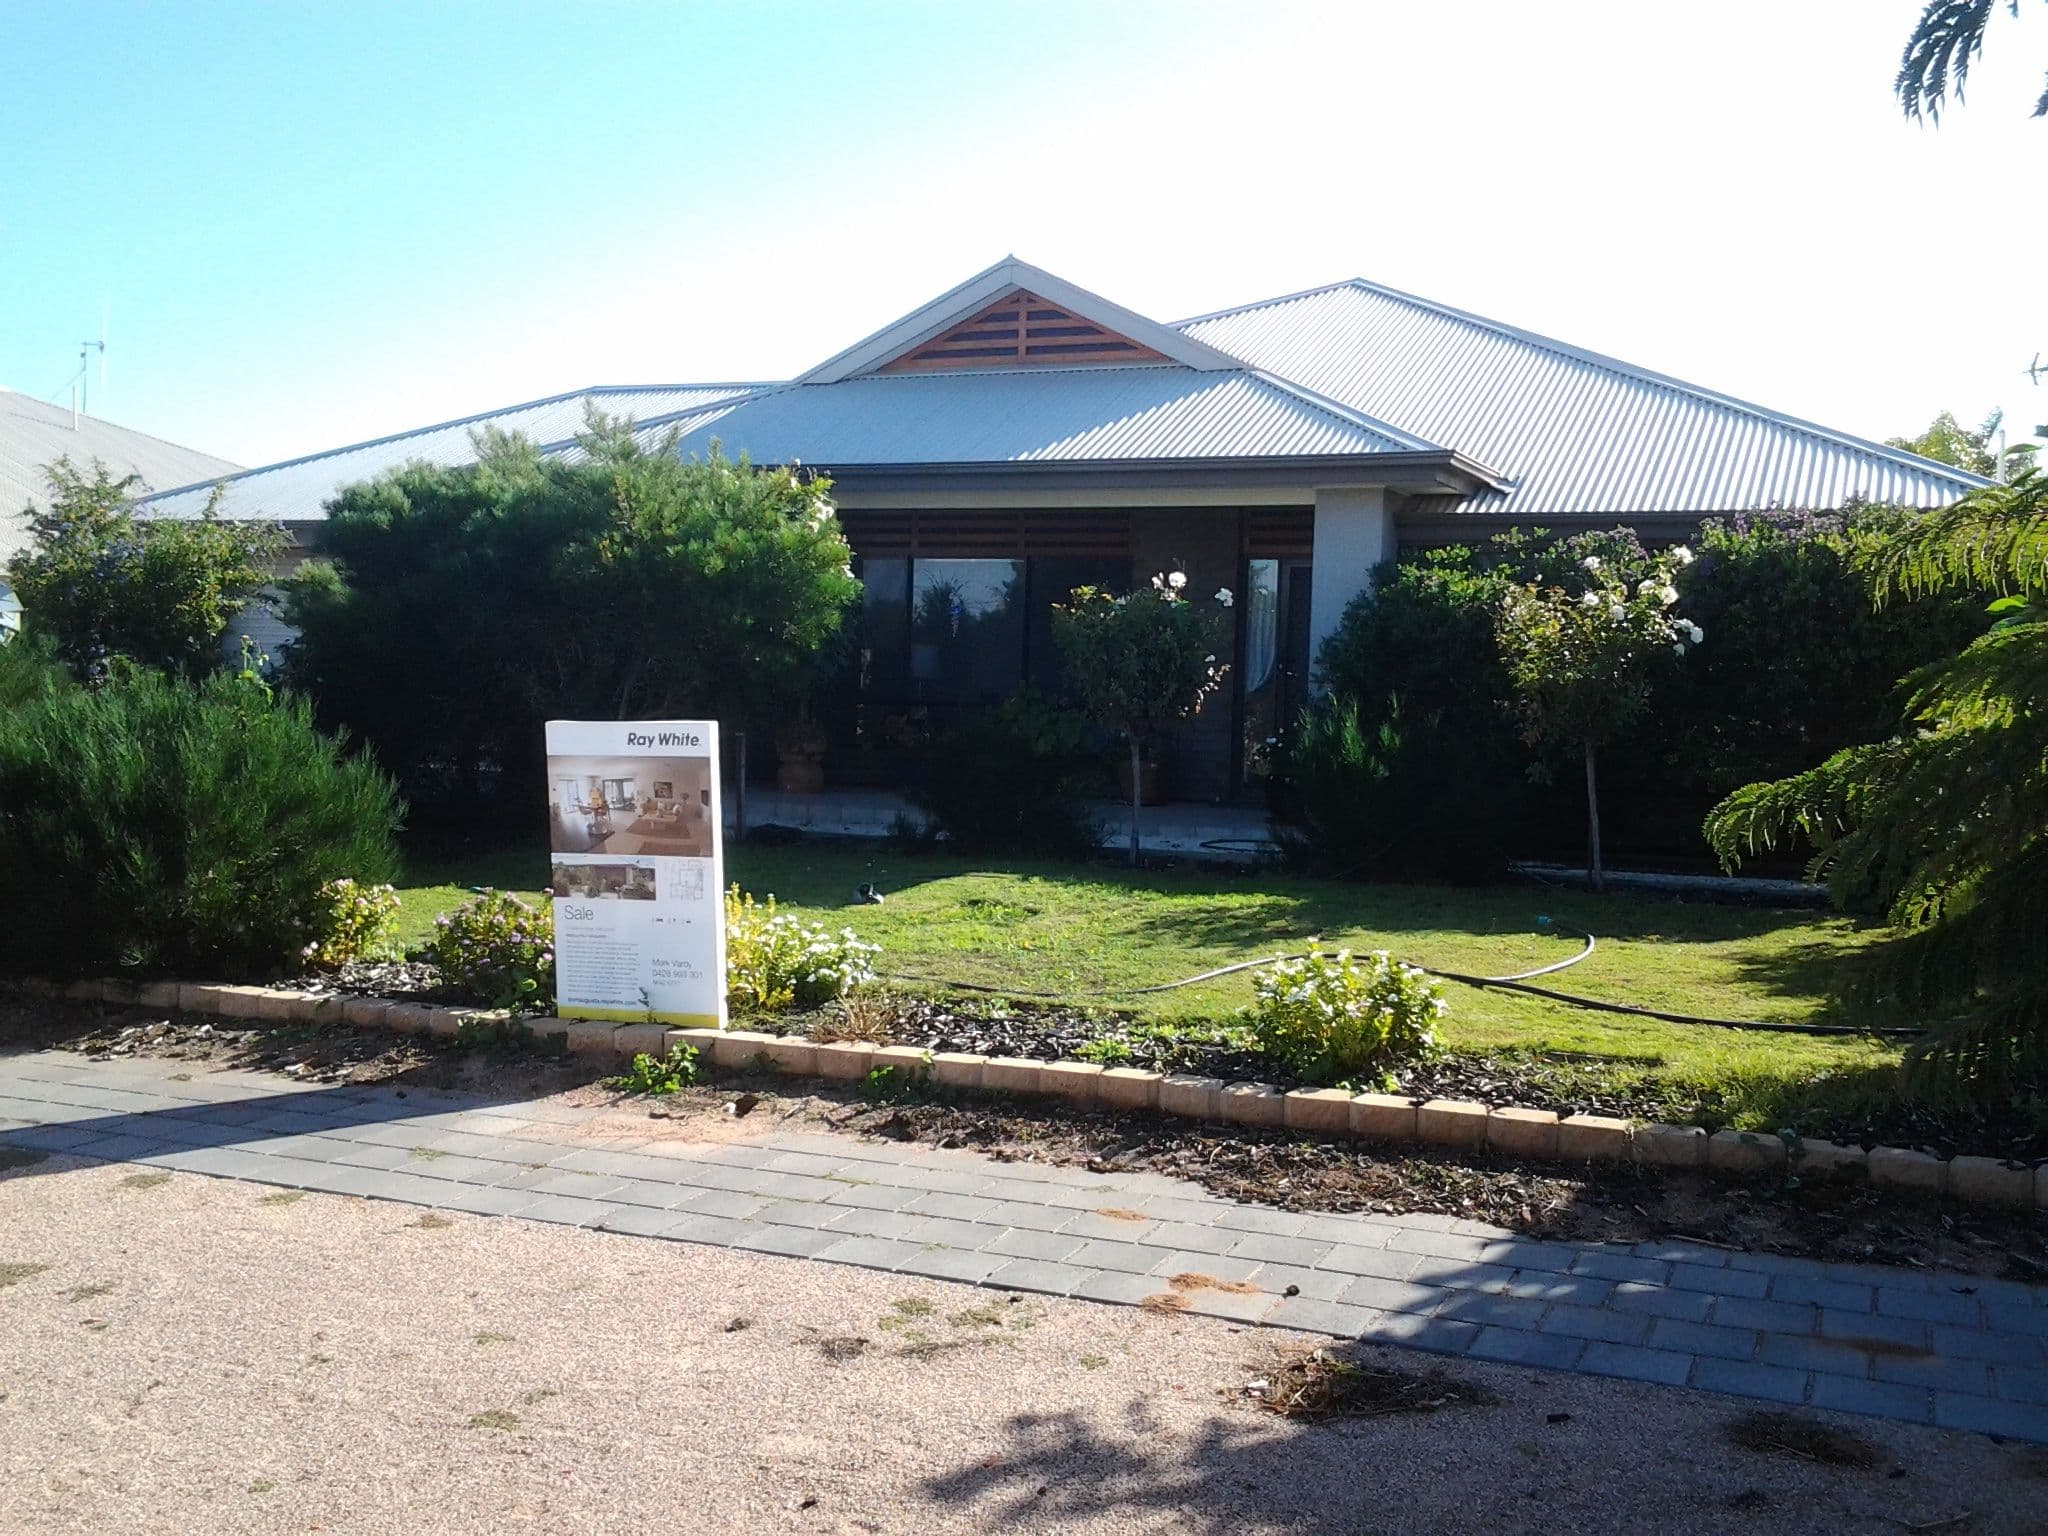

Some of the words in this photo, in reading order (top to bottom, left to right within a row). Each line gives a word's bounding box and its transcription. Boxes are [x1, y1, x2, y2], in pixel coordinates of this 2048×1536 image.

[627, 732, 655, 748] Ray
[659, 733, 700, 747] White
[564, 904, 594, 921] Sale
